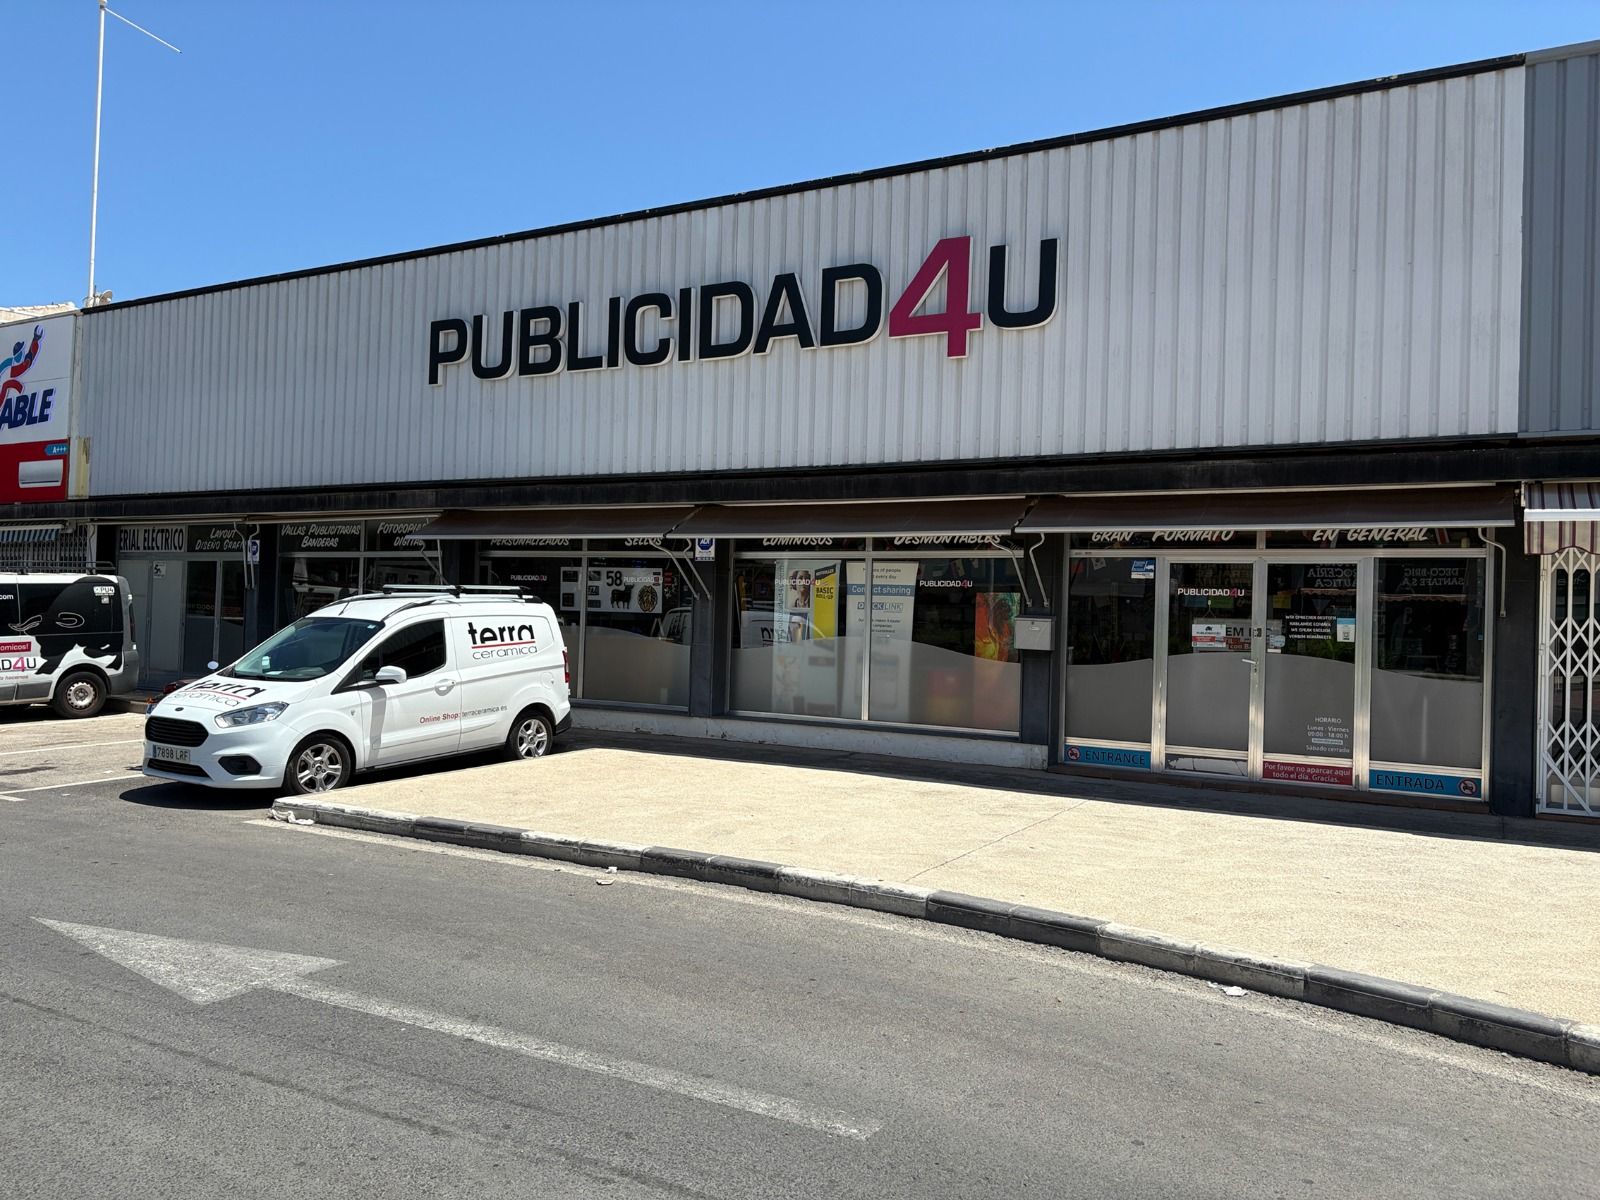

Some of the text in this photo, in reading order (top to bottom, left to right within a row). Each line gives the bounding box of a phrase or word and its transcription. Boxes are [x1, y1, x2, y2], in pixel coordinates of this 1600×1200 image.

[428, 235, 1060, 386] PUBLICIDAD4U
[0, 388, 54, 430] ABLE
[210, 527, 236, 539] LAYOUT
[281, 523, 361, 536] VALLAS PUBLICITARIAS
[1091, 530, 1235, 542] GRAN FORMATO
[1312, 529, 1429, 542] EN GENERAL
[143, 526, 184, 551] ELÉCTRICO
[195, 539, 221, 550] DISEÑO
[301, 536, 339, 548] BANDERAS
[606, 570, 622, 587] 58
[919, 579, 973, 588] PUBLICIDAD4U
[851, 585, 911, 595] Conct sharing
[1177, 586, 1245, 598] PUBLICIDAD4U
[467, 621, 535, 645] terra
[472, 645, 538, 660] ceramica
[419, 716, 441, 724] Online
[1315, 716, 1342, 724] HORARIO
[1084, 750, 1146, 766] ENTRANCE
[1264, 762, 1276, 770] Por
[1277, 763, 1295, 771] favor
[1306, 766, 1333, 775] aparcar
[1273, 771, 1289, 779] todo
[1375, 773, 1445, 791] ENTRADA
